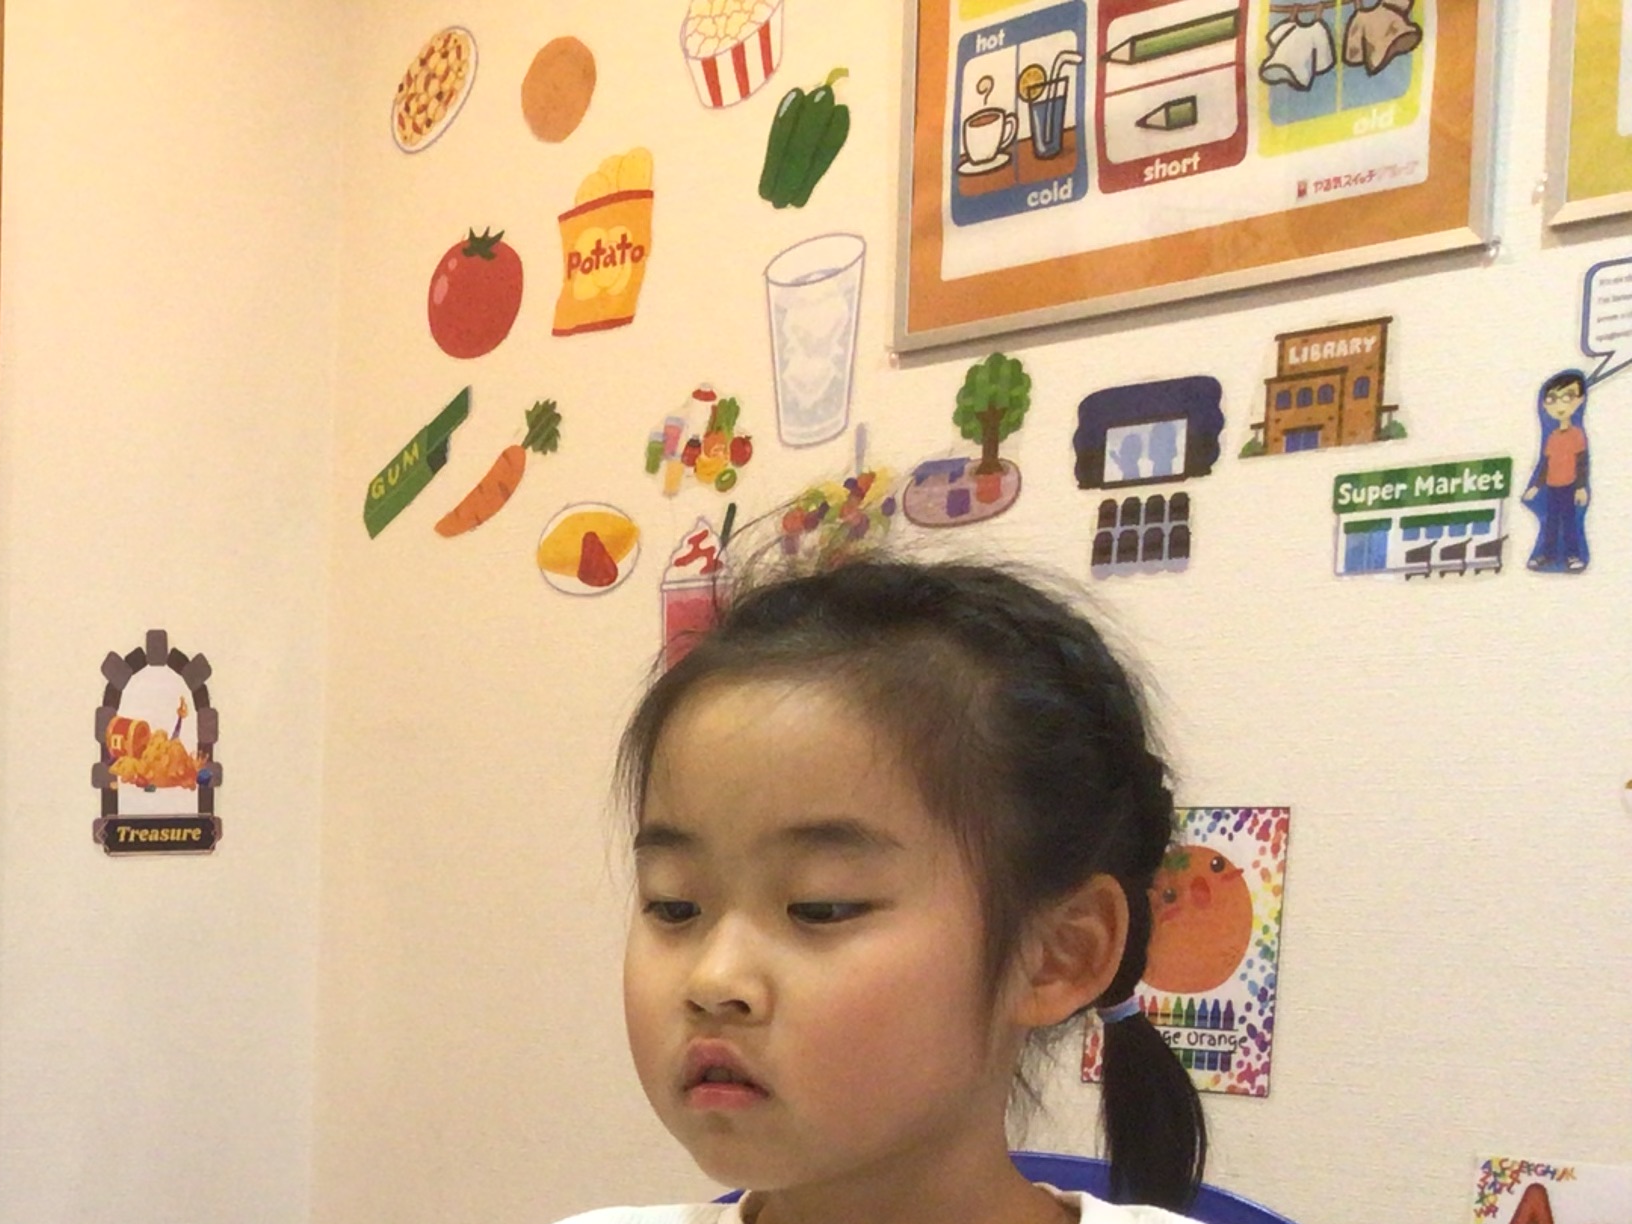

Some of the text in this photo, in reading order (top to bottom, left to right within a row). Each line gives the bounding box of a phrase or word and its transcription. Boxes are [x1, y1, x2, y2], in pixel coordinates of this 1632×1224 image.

[976, 31, 1005, 53] hot
[1352, 106, 1395, 136] old
[1143, 154, 1201, 183] short
[1026, 178, 1074, 208] cold
[1288, 335, 1377, 365] LIBRARY
[371, 441, 419, 500] GUM
[1337, 467, 1505, 506] Super Market
[117, 825, 202, 843] Treasure
